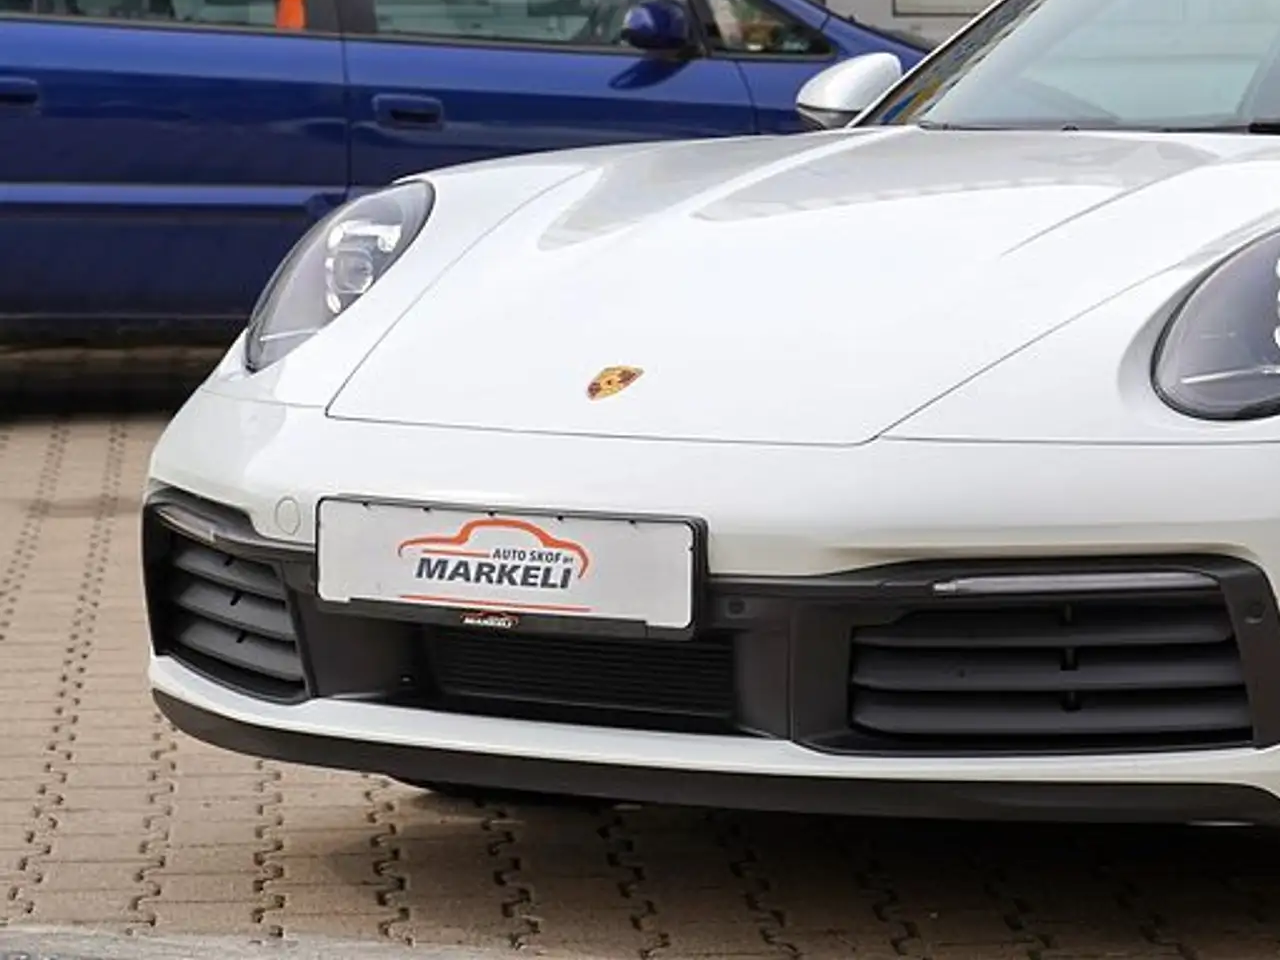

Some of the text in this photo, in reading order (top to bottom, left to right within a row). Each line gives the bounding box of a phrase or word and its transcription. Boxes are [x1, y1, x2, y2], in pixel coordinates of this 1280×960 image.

[492, 547, 526, 561] AUTO
[529, 549, 562, 564] SKOF
[415, 556, 573, 590] MARKELI
